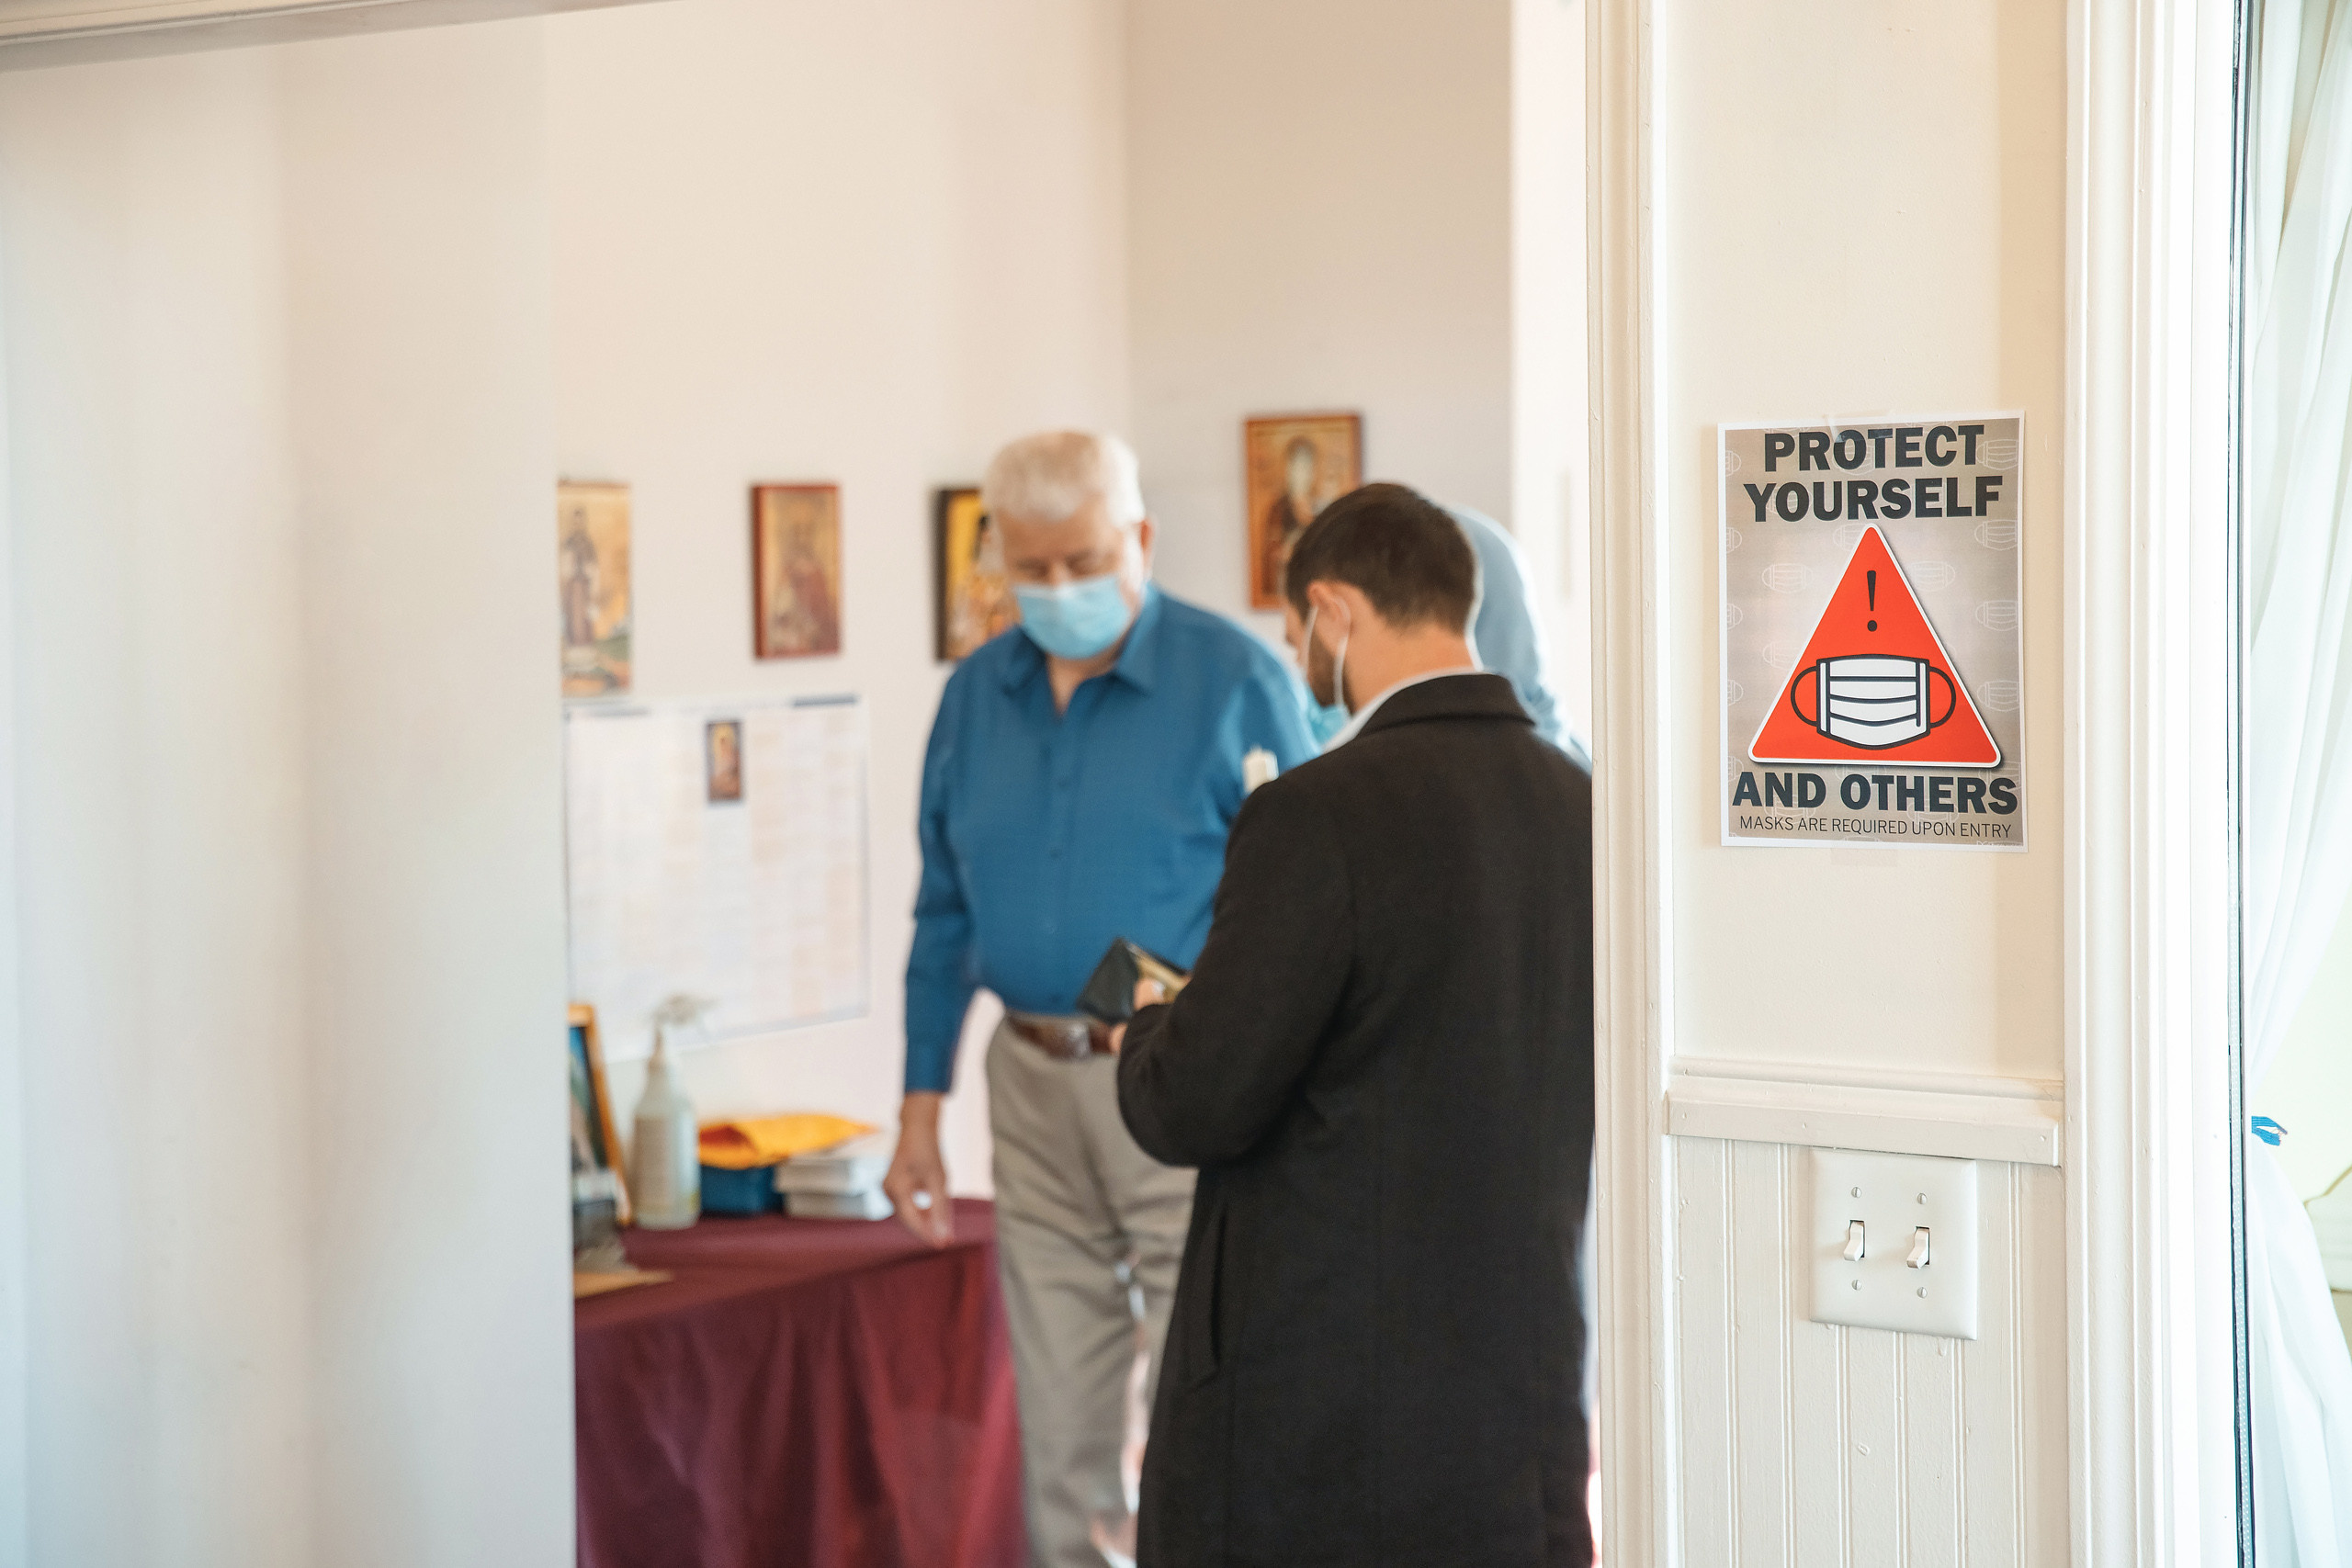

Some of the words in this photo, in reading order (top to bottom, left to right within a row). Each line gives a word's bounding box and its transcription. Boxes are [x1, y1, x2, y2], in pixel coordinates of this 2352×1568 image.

[1765, 425, 1984, 472] PROTECT
[1744, 476, 2003, 522] YOURSELF
[1732, 772, 1826, 807] AND
[1840, 773, 2018, 815] OTHERS
[1740, 816, 1793, 830] MASKS
[1798, 818, 1827, 831] ARE
[1832, 818, 1907, 834] REQUIRED
[1912, 821, 1956, 837] UPON
[1961, 823, 2012, 838] ENTRY
